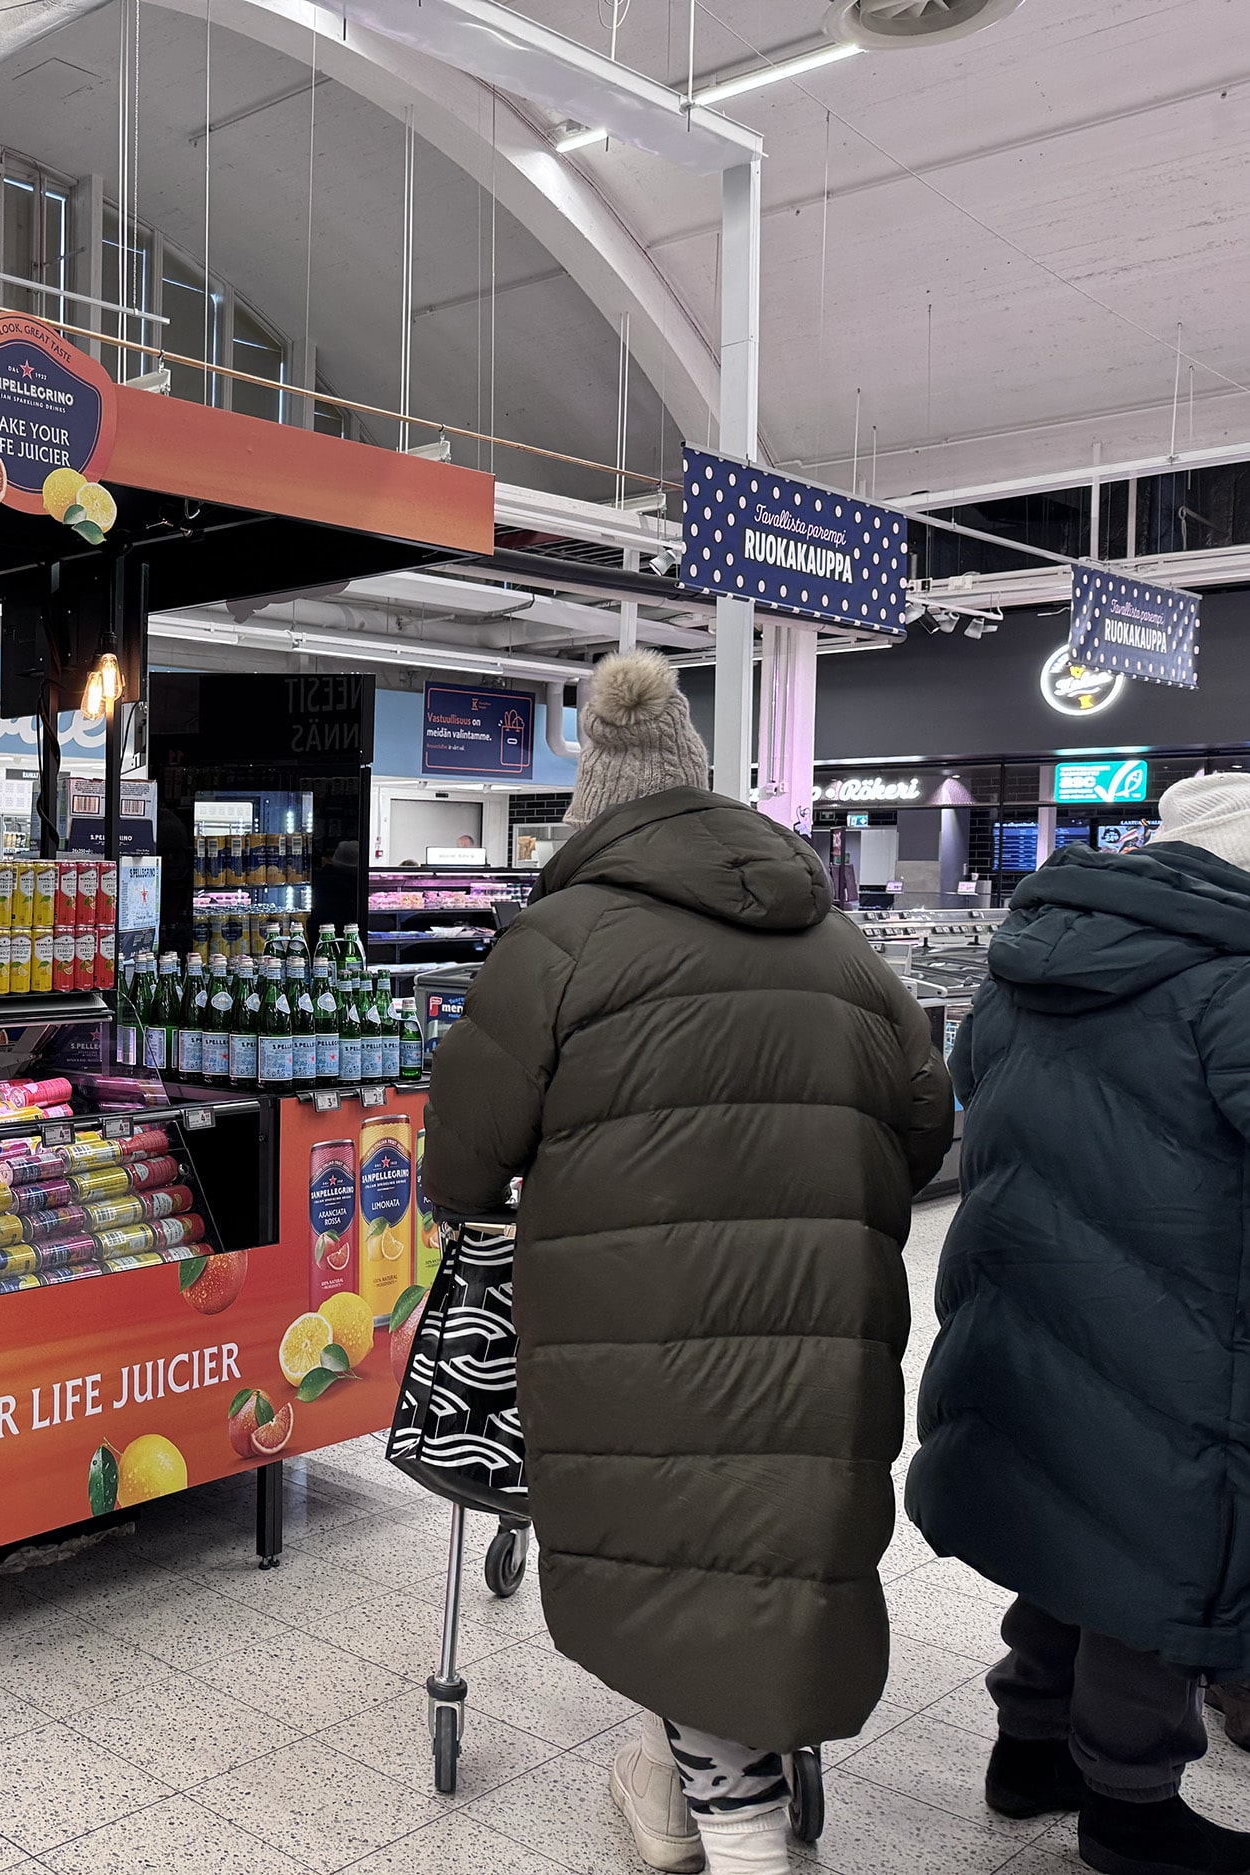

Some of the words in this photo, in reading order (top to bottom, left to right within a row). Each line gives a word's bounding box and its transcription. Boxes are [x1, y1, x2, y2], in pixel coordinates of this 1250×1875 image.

[24, 325, 49, 345] GREAT
[50, 340, 72, 364] TASTE
[7, 365, 19, 374] DAL
[13, 395, 44, 409] SPARKLING
[45, 403, 66, 414] DRINKS
[29, 423, 71, 447] YOUR
[17, 445, 71, 467] JUICIER
[754, 503, 807, 535] Tavallista
[806, 525, 847, 548] parempi
[744, 528, 853, 584] RUOKAKAUPPA
[1104, 618, 1167, 654] RUOKAKAUPPA
[427, 712, 471, 725] Vastuullisuus
[426, 727, 451, 738] meidän
[452, 729, 492, 741] valintamme.
[361, 1168, 409, 1184] SANPELLEGRINO
[311, 1185, 354, 1199] SANPELLEGRINO
[371, 1199, 400, 1211] LIMONATA
[318, 1209, 347, 1219] ARANCIATA
[324, 1216, 341, 1226] ROSSA
[31, 1373, 104, 1430] LIFE
[112, 1342, 242, 1410] JUICIER
